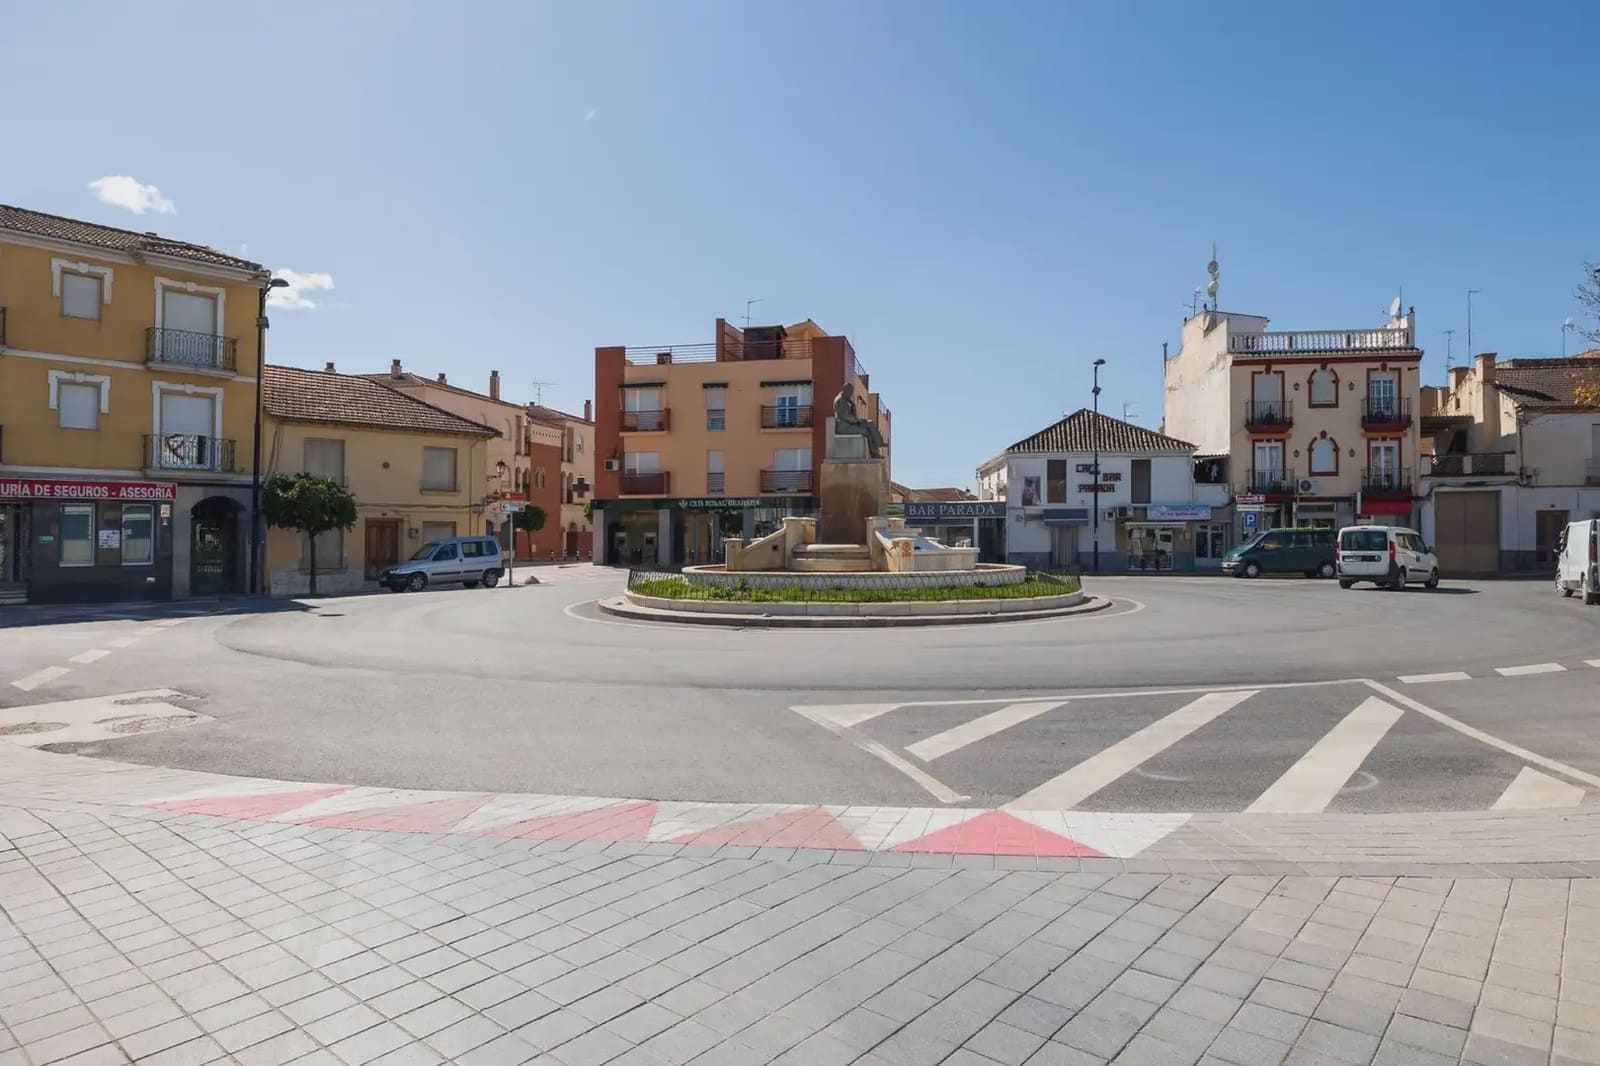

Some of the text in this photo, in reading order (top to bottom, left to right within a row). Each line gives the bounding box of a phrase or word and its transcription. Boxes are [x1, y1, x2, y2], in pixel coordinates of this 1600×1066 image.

[1102, 472, 1122, 482] BAR
[34, 484, 51, 496] DE
[54, 485, 109, 497] SEGUROS
[909, 504, 996, 515] BAR PARADA
[1246, 514, 1255, 526] P
